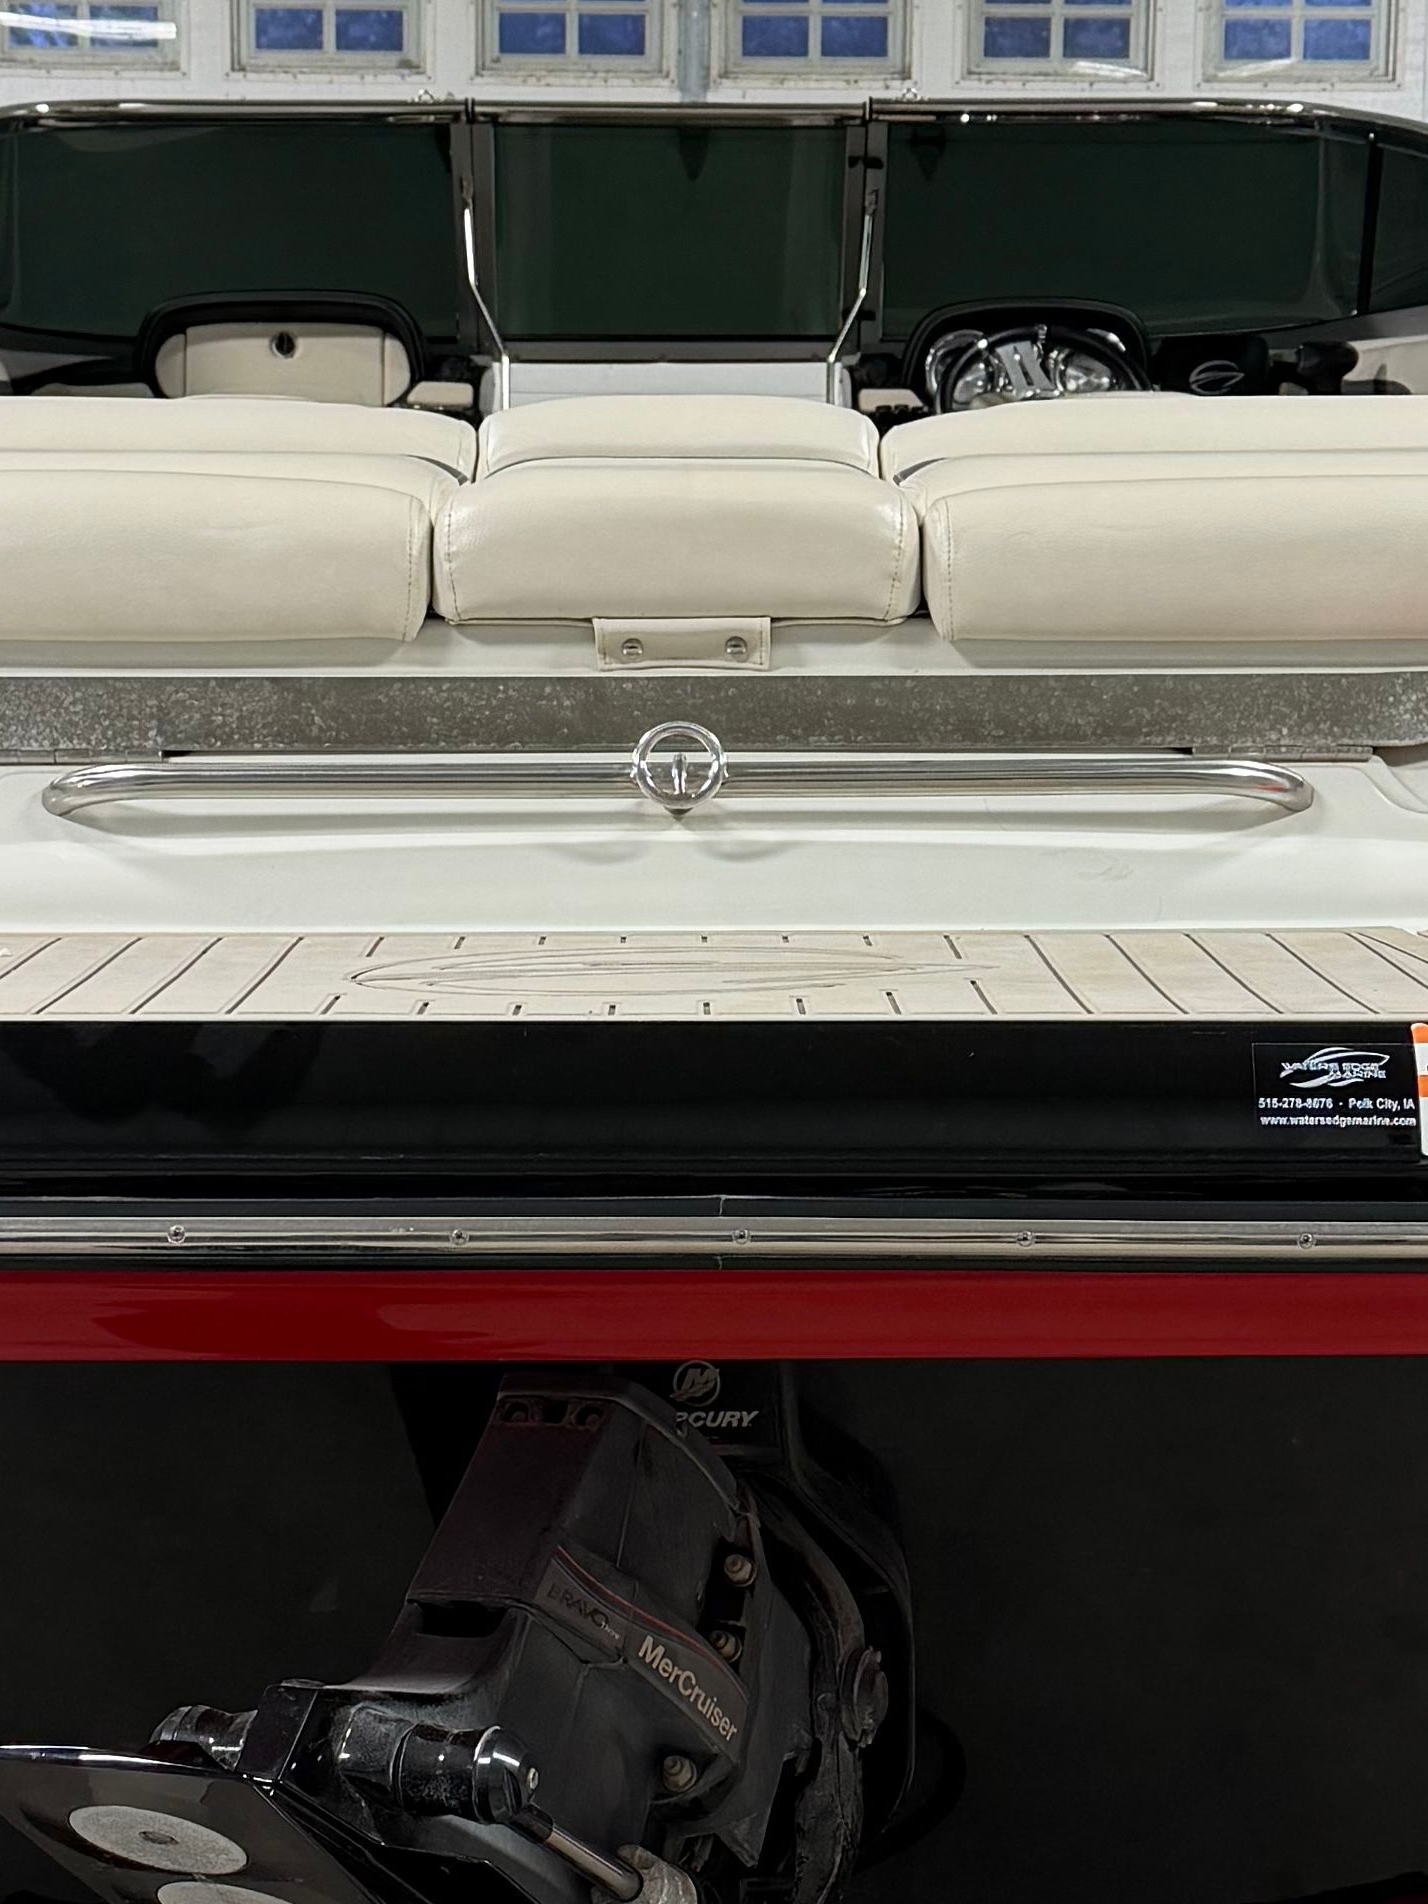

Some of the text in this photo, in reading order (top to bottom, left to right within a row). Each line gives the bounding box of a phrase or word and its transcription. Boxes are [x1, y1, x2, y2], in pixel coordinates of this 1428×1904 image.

[1342, 1062, 1379, 1071] EDGE
[1376, 1097, 1401, 1111] City,
[1403, 1097, 1416, 1109] IA
[1260, 1114, 1416, 1127] www.watersedgemarine.com
[676, 1411, 759, 1428] RCURY
[547, 1583, 609, 1627] BRAVO
[638, 1634, 737, 1741] MerCruiser
